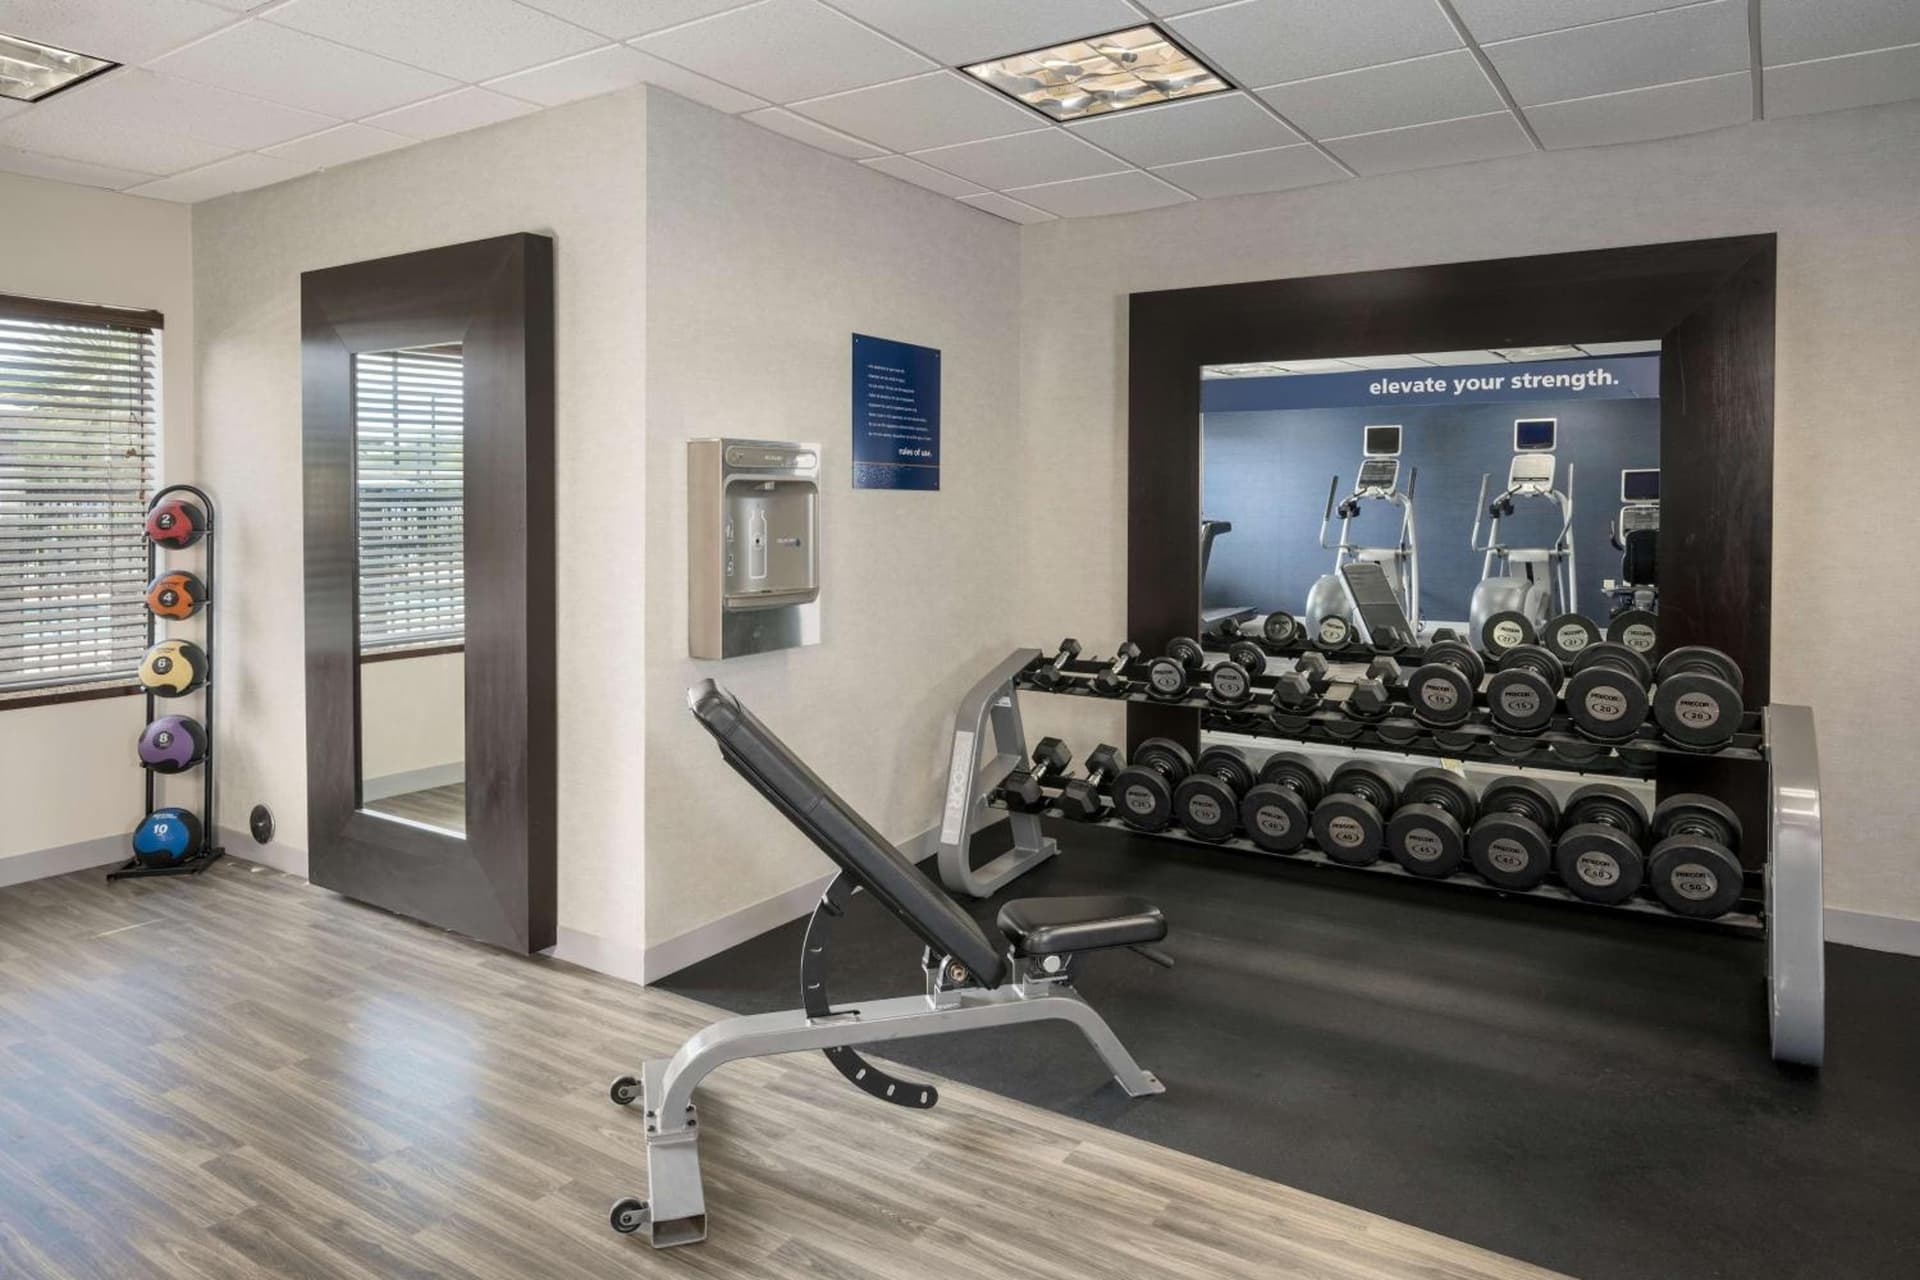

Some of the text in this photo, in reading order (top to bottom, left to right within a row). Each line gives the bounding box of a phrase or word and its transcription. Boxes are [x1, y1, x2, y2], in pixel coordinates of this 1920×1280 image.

[1369, 368, 1619, 396] elevate your strength.
[914, 447, 921, 456] of
[161, 513, 170, 524] 2
[162, 592, 172, 602] 4
[157, 658, 166, 667] 6
[159, 731, 168, 742] 8
[153, 823, 169, 834] 10
